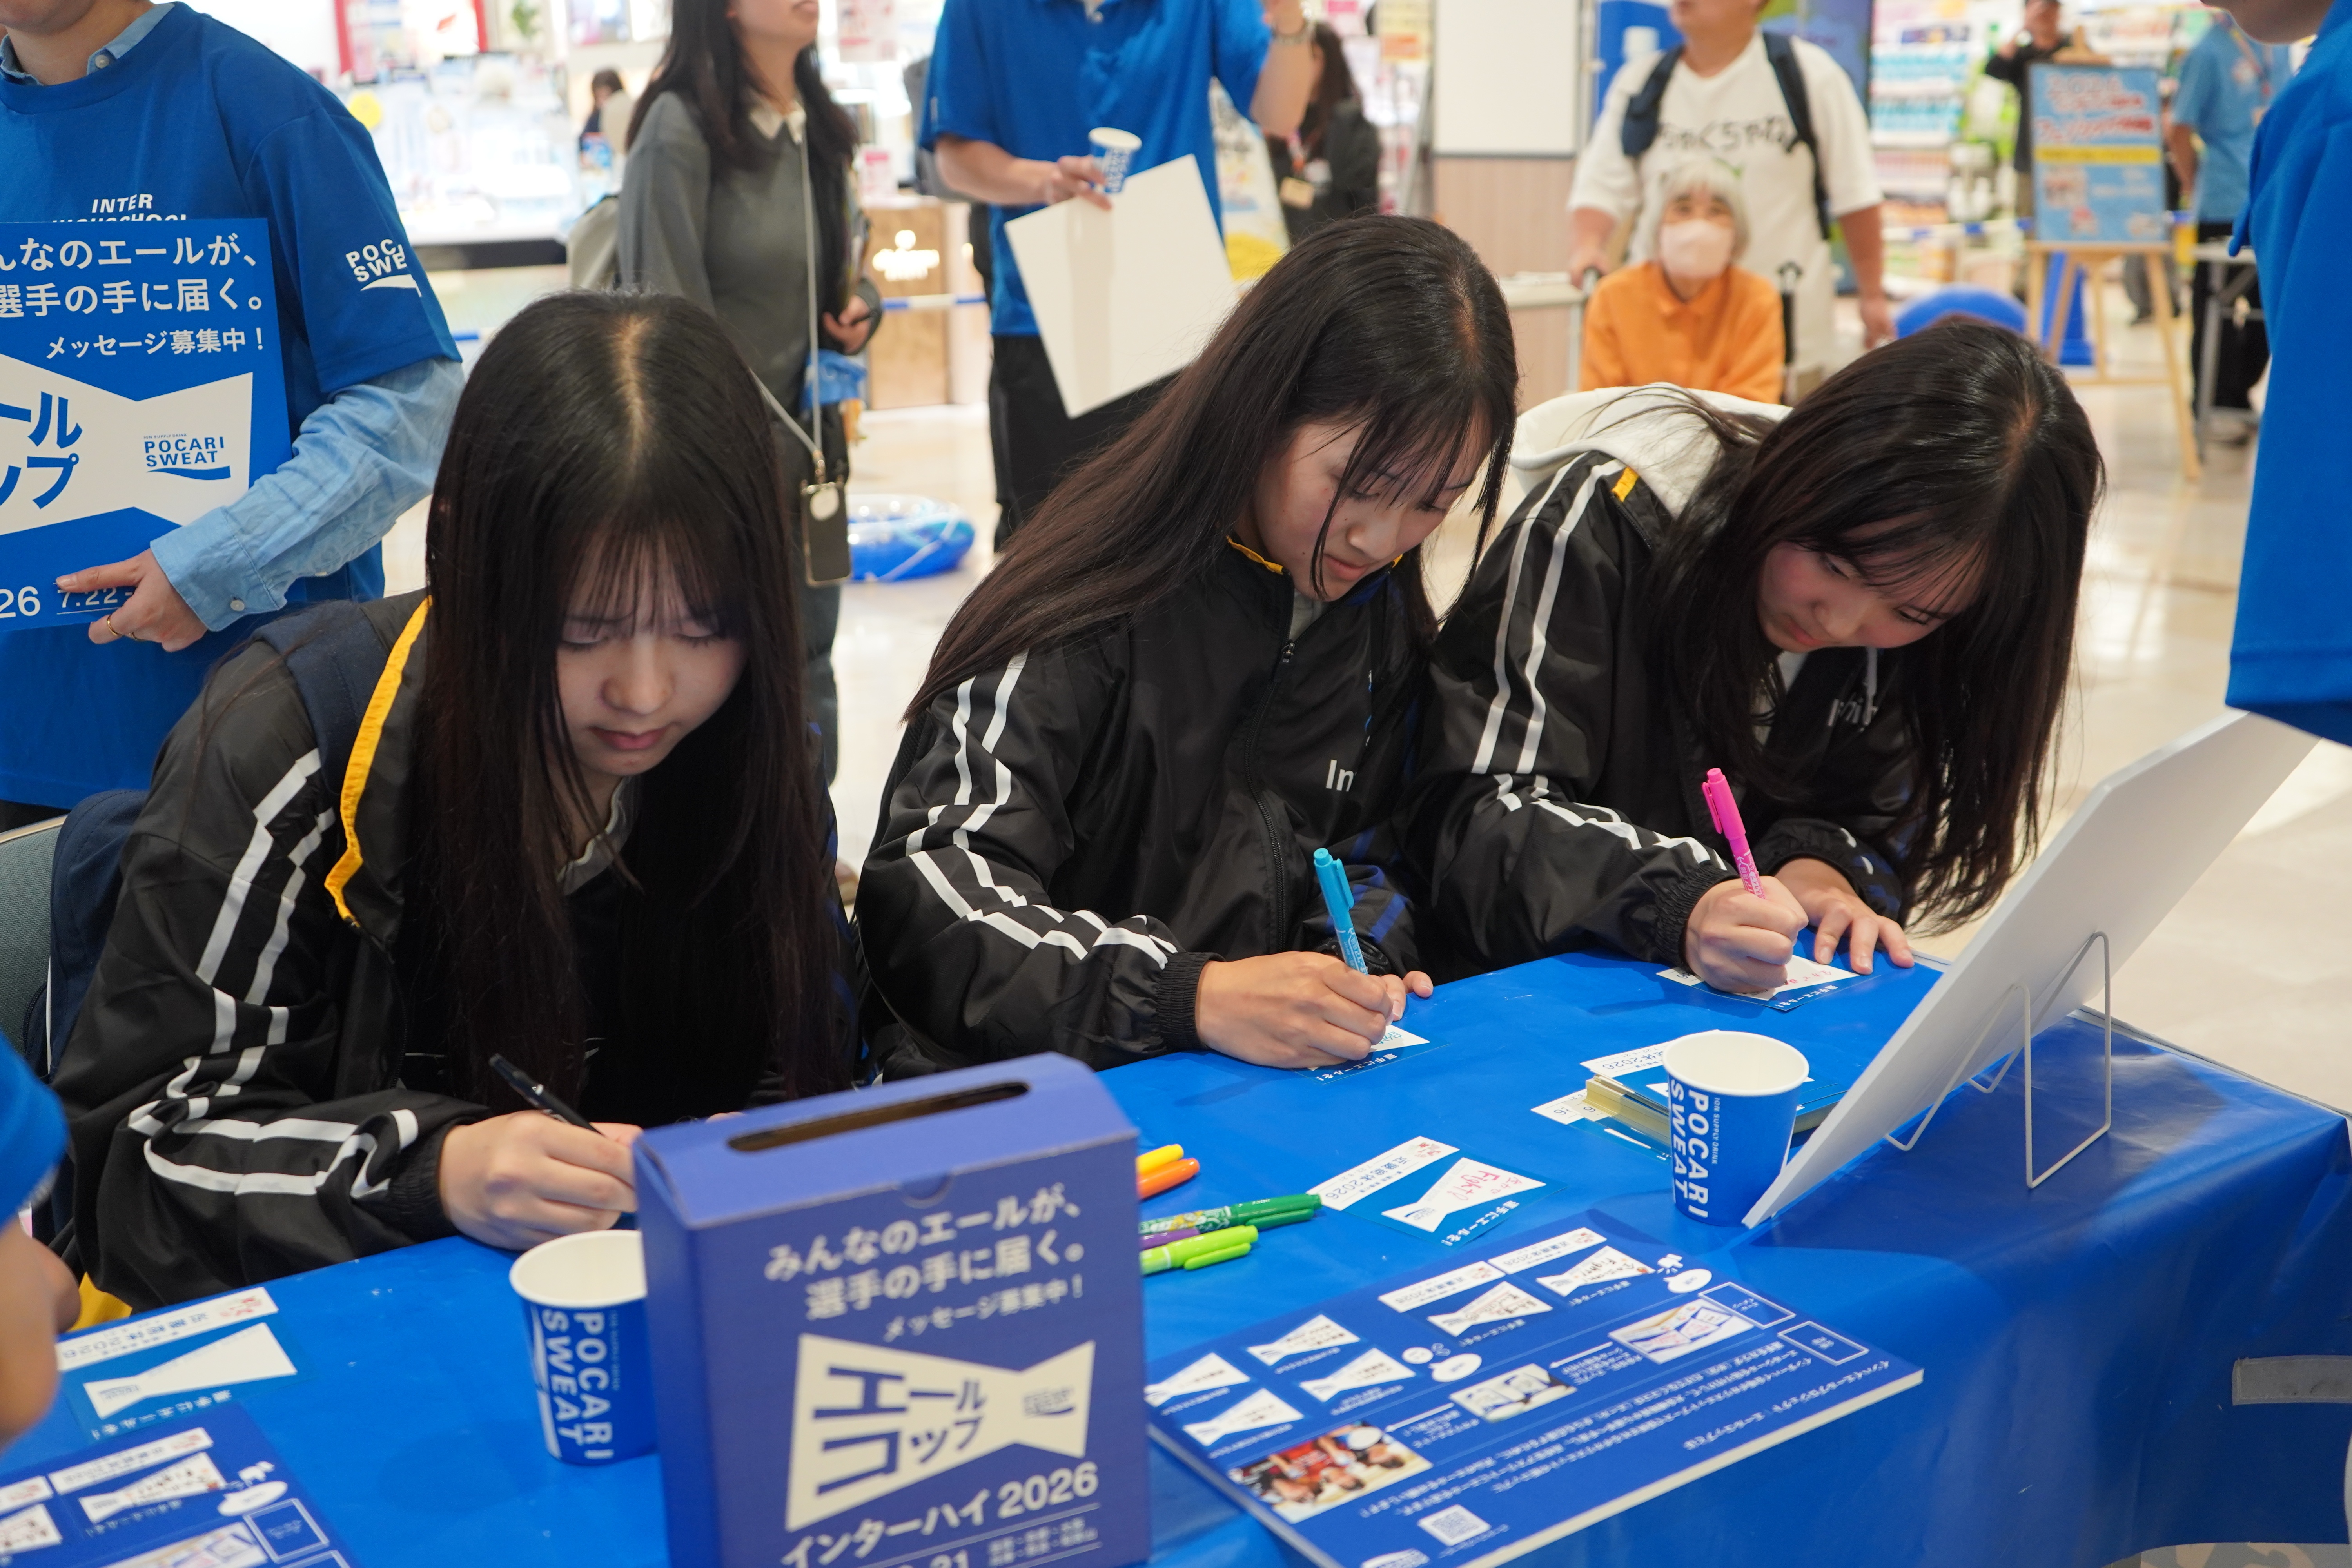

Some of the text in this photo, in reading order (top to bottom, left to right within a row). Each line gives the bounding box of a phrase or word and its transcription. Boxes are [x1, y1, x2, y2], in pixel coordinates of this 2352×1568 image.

[91, 193, 153, 214] INTER
[0, 278, 262, 318] 選手の手に届く。
[46, 327, 264, 359] メッセージ募集中！
[144, 436, 225, 454] POCARI
[146, 450, 218, 467] SWEAT
[1713, 1097, 1721, 1113] ION
[1670, 1078, 1688, 1199] SWEAT
[1688, 1089, 1709, 1218] POCARI
[1711, 1142, 1719, 1165] DRINK
[764, 1182, 1081, 1282] みんなのエールが、
[805, 1230, 1085, 1321] 選手の手に届く。
[541, 1308, 584, 1446] SWEAT
[573, 1312, 615, 1460] POCARI
[811, 1366, 988, 1420] エール
[815, 1415, 984, 1496] コップ
[997, 1461, 1099, 1519] 2026
